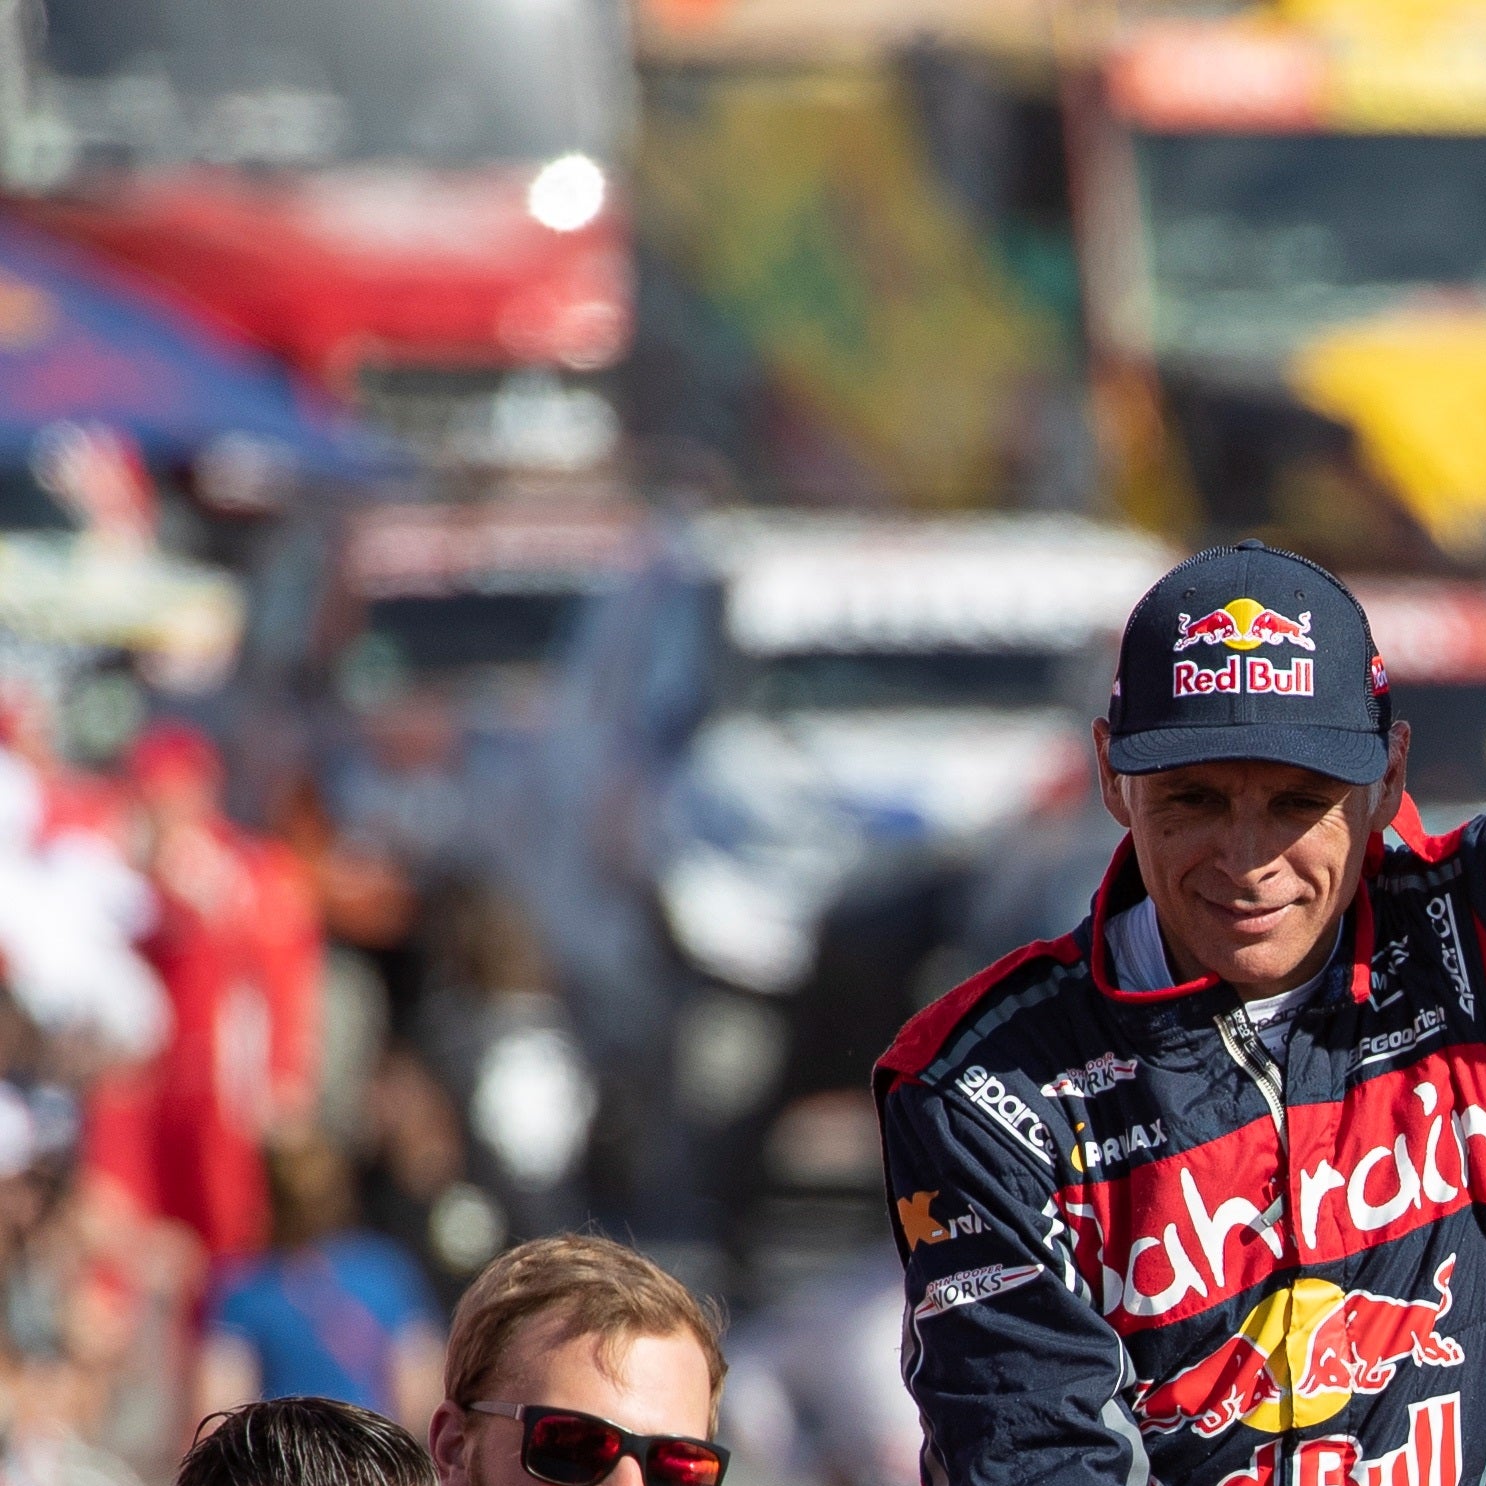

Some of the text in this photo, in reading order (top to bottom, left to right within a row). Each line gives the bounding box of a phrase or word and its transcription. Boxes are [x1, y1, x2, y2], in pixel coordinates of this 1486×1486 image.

[1172, 654, 1241, 698] Red
[1246, 656, 1315, 697] Bull
[1085, 1118, 1169, 1169] PRIAX
